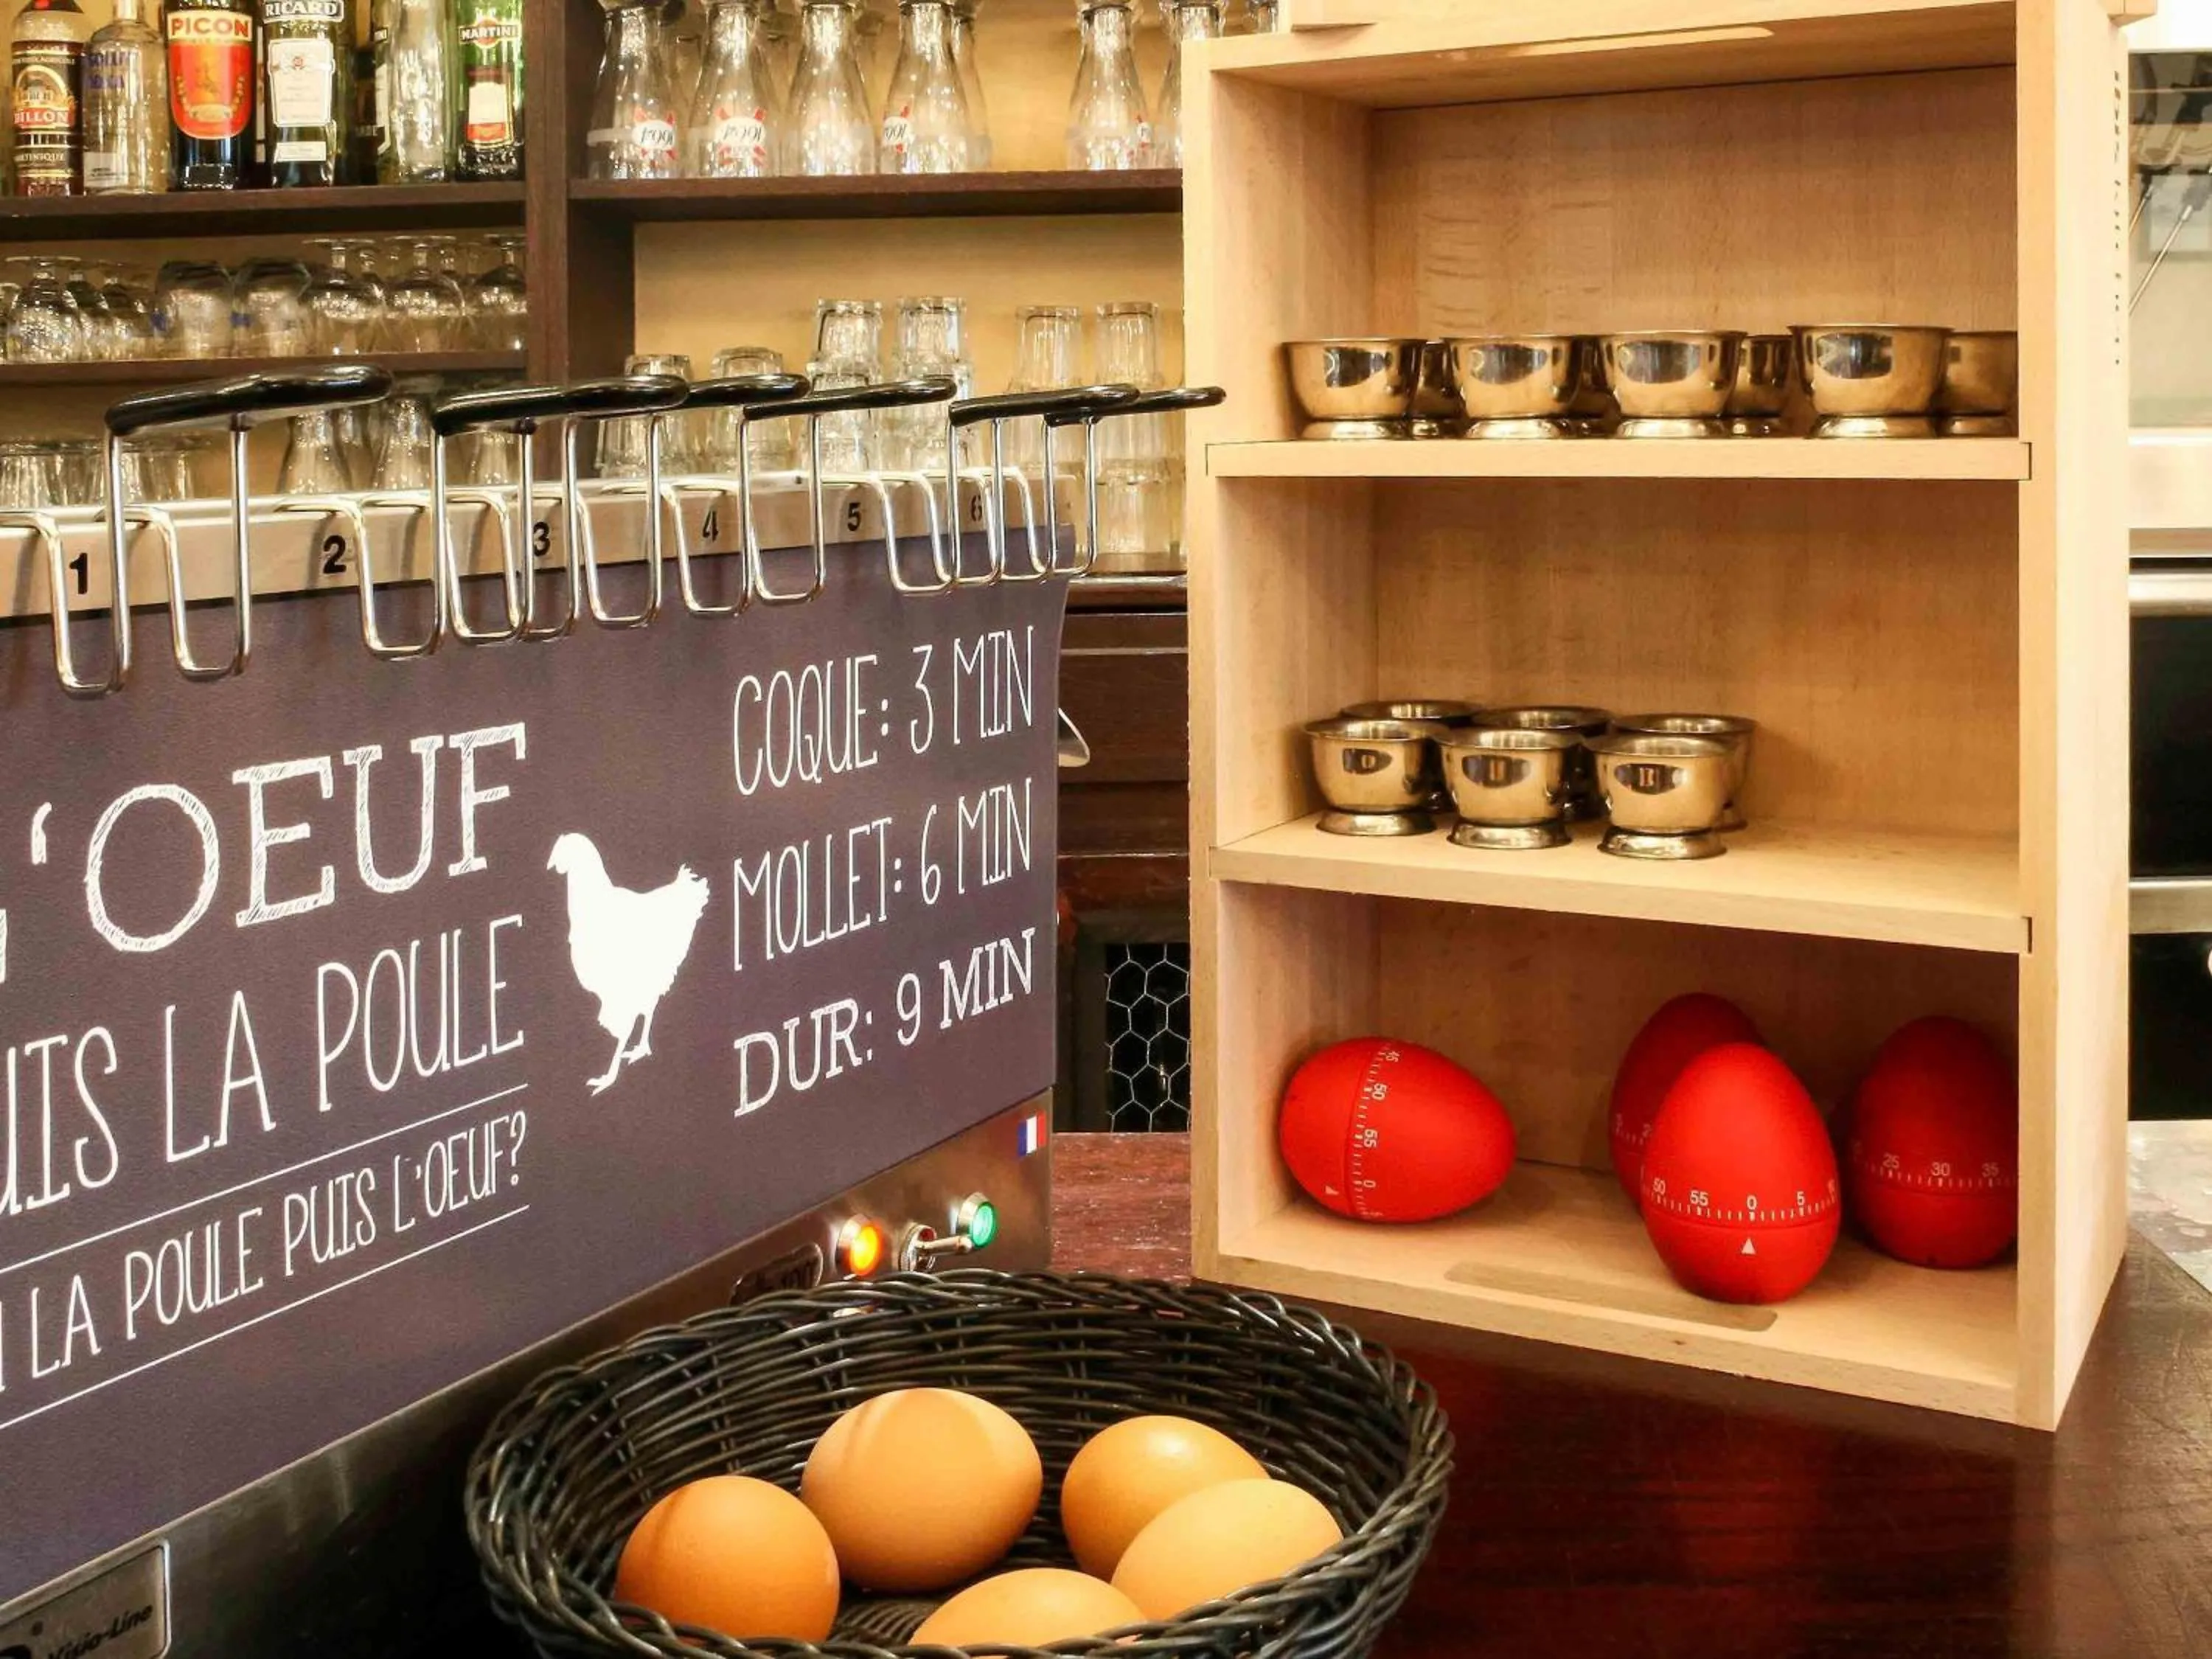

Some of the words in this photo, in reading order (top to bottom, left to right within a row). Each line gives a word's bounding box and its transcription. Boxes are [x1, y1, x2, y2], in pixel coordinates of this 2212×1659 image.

[265, 1, 337, 17] RICARD
[171, 17, 249, 36] PICON
[462, 25, 516, 40] MARTINI
[847, 502, 862, 532] 5
[971, 495, 984, 522] 6
[532, 521, 551, 557] 3
[702, 511, 719, 543] 4
[322, 535, 347, 574] 2
[69, 553, 88, 594] 1
[734, 654, 888, 796] COQUE:
[911, 644, 933, 754] 3
[953, 625, 1033, 745] MIN
[0, 722, 526, 984] 'OEUF
[734, 817, 902, 972] MOLLET:
[921, 804, 941, 905] 6
[959, 778, 1032, 894] MIN
[166, 991, 276, 1163] LA
[318, 914, 524, 1112] POULE
[734, 998, 873, 1119] DUR:
[896, 973, 922, 1046] 9
[939, 928, 1035, 1029] MIN
[1371, 1082, 1388, 1101] 50
[1363, 1129, 1378, 1149] 55
[1883, 1153, 1900, 1169] 25
[1931, 1162, 1951, 1177] 30
[1981, 1163, 2000, 1178] 35
[1363, 1180, 1377, 1189] 0
[1690, 1189, 1709, 1207] 55
[1746, 1194, 1759, 1211] 0
[1796, 1191, 1806, 1206] 5
[31, 1275, 101, 1379] LA
[125, 1207, 263, 1340] POULE
[284, 1167, 377, 1276] PUIS
[394, 1110, 526, 1233] L'OEUF?
